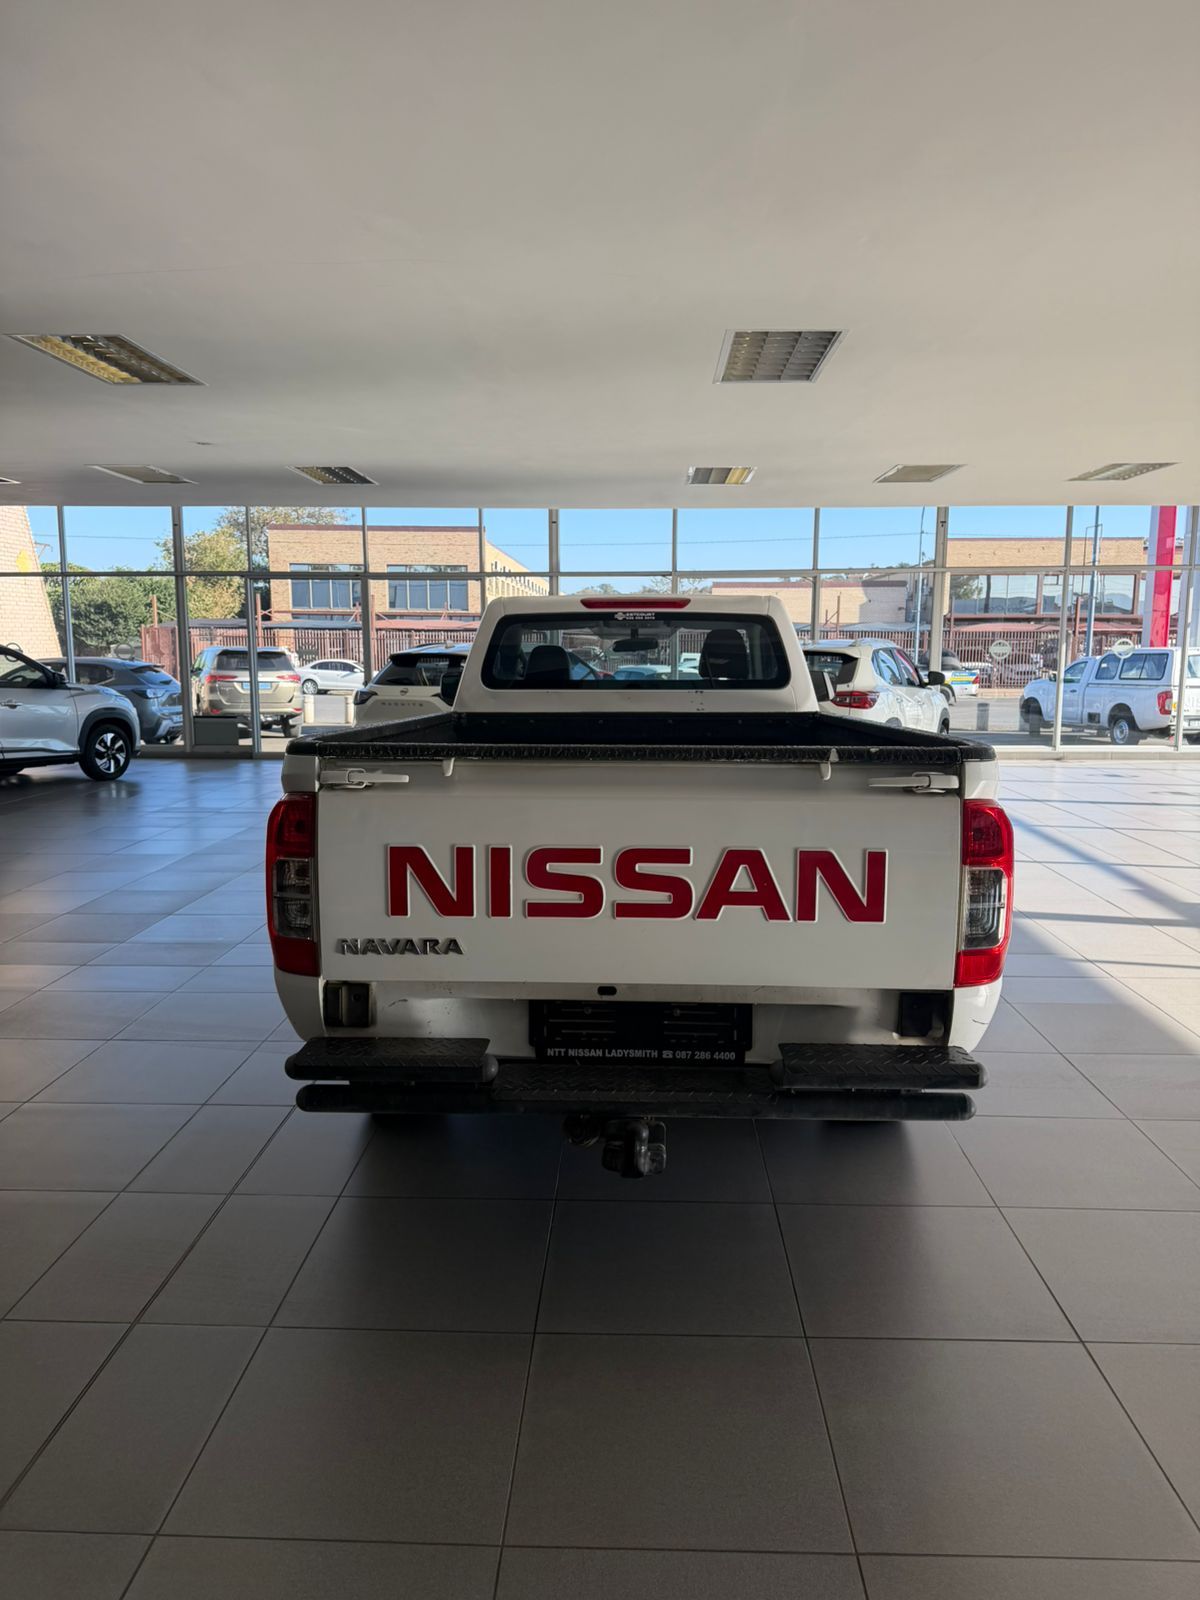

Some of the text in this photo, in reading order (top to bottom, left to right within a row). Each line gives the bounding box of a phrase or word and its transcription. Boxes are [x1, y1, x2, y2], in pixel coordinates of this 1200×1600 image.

[386, 844, 888, 923] NISSAN
[335, 938, 465, 955] NAVARA
[547, 1048, 736, 1060] NTT NISSAN LADYSMITH 087 286 4400
